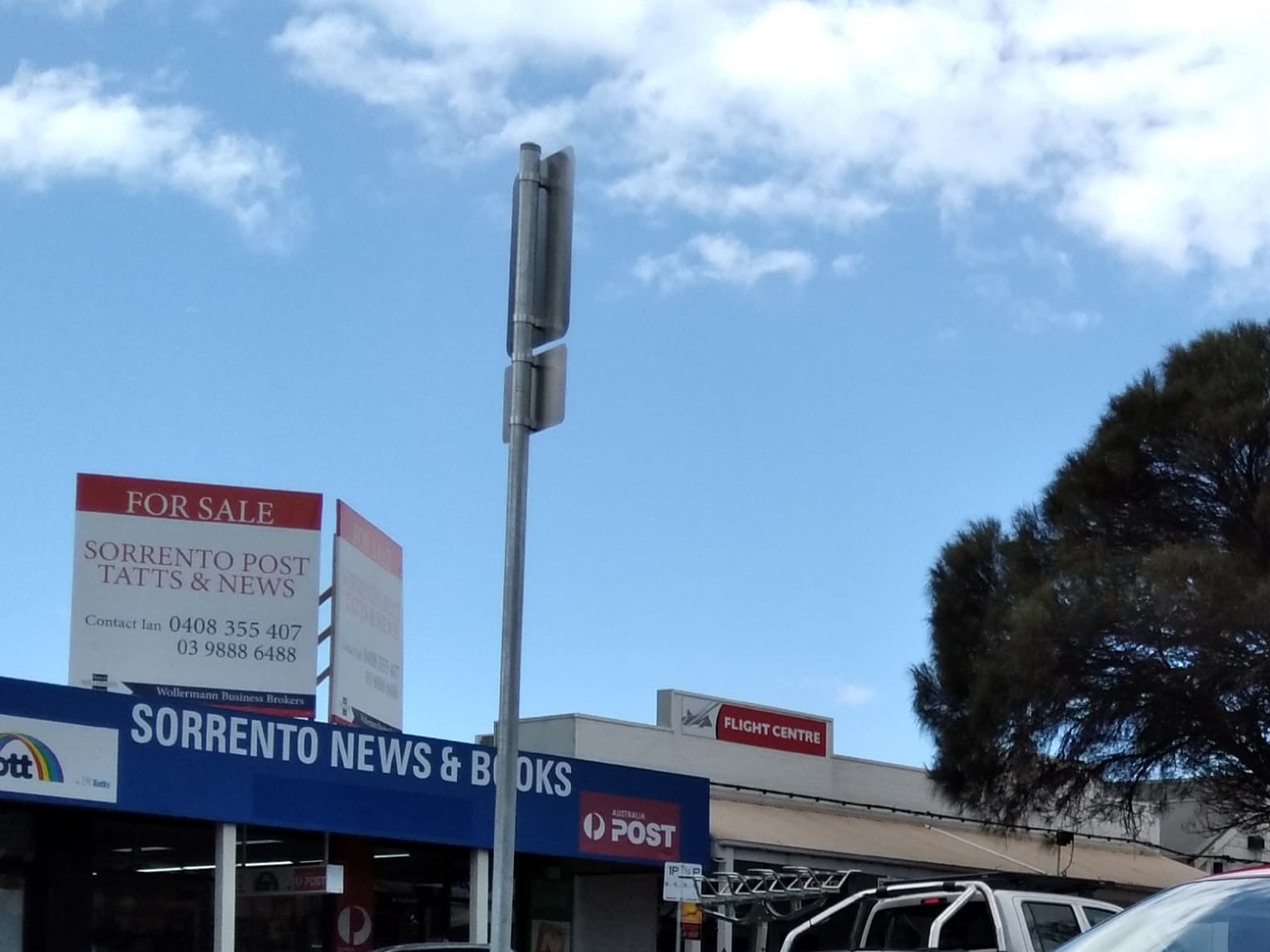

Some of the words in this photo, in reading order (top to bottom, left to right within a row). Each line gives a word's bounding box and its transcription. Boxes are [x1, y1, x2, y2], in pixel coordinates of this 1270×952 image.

[126, 490, 190, 519] FOR
[198, 496, 274, 525] SALE
[84, 539, 234, 571] SORRENTO
[243, 552, 310, 576] POST
[98, 564, 183, 590] TATTS
[190, 572, 210, 593] &
[218, 574, 296, 599] NEWS
[85, 614, 137, 630] Contact
[141, 618, 162, 631] Ian
[169, 616, 217, 636] 0408
[224, 620, 260, 638] 355
[266, 623, 302, 642] 407
[177, 639, 199, 656] 03
[205, 641, 248, 660] 9888
[253, 644, 297, 663] 6488
[156, 686, 219, 702] Wollermann
[222, 692, 264, 704] Business
[266, 694, 305, 706] Brokers
[131, 703, 318, 765] SORRENTO
[331, 730, 432, 779] NEWS
[440, 746, 461, 783] &
[724, 716, 770, 736] FLIGHT
[772, 725, 821, 744] CENTRE
[612, 809, 646, 820] AUSTRALIA
[612, 818, 676, 848] POST
